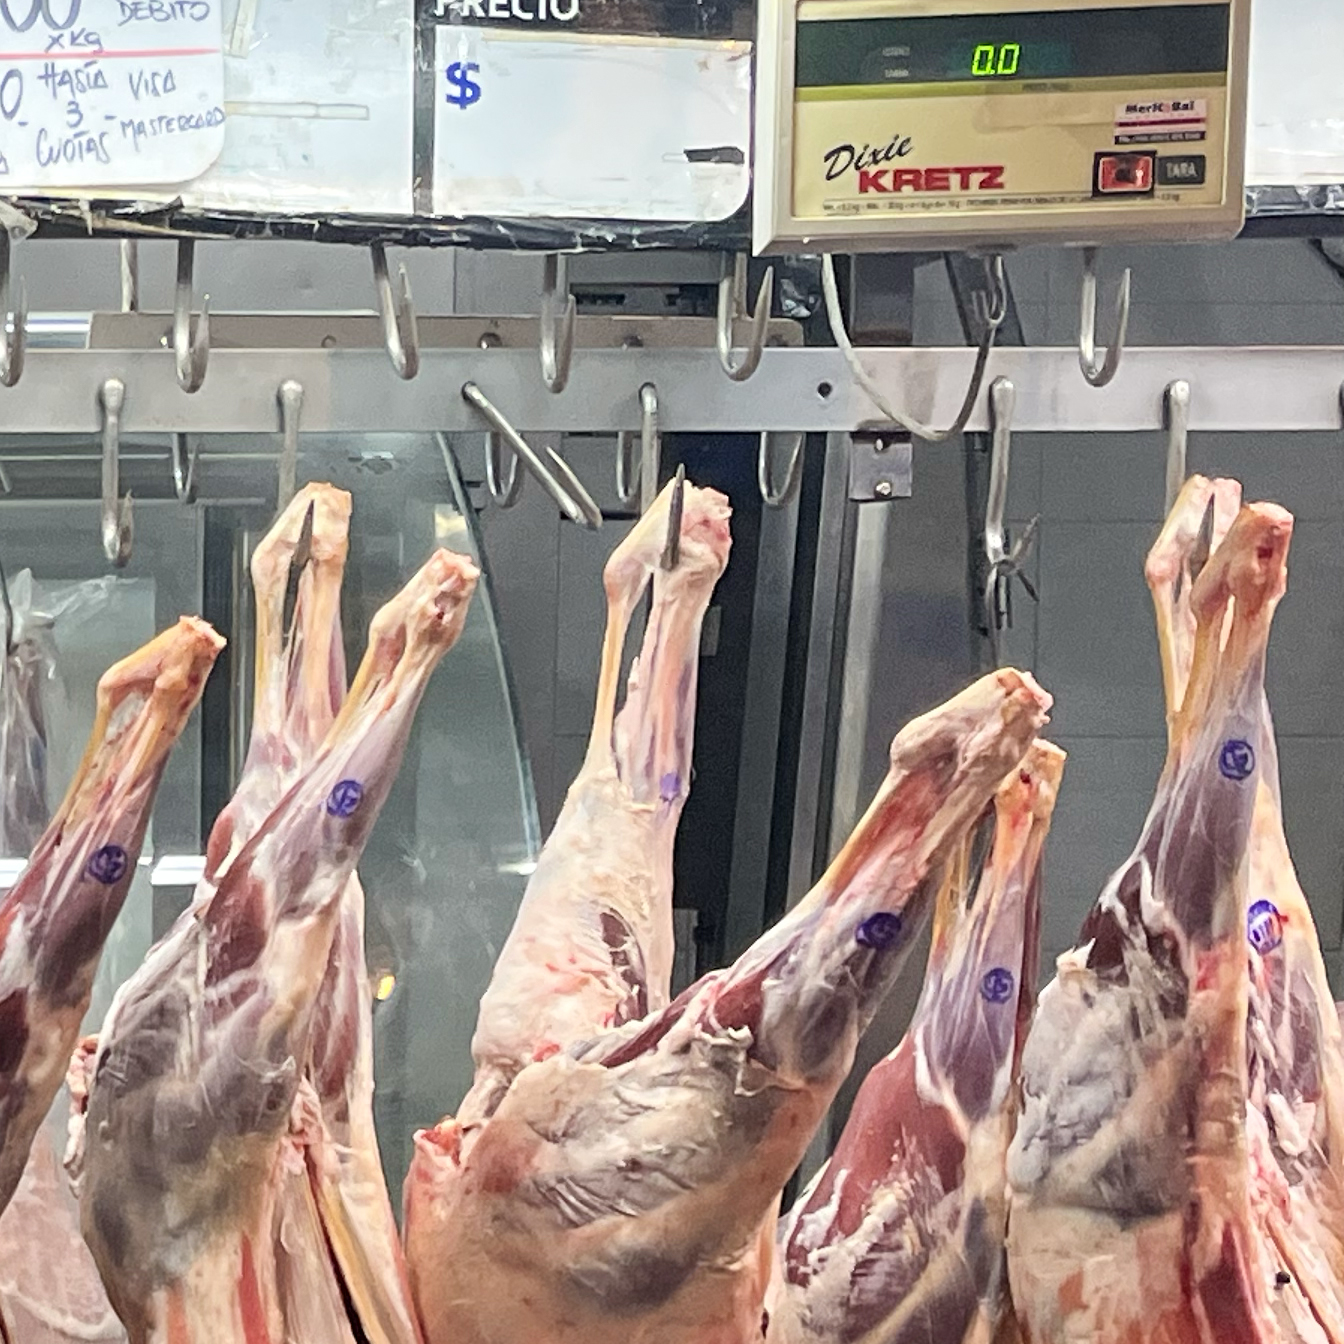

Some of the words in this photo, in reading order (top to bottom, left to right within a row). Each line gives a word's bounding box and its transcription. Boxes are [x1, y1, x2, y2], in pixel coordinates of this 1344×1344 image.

[117, 0, 211, 26] DEBITO
[971, 43, 1019, 76] 0.0
[445, 61, 482, 110] $
[65, 101, 85, 127] 3
[823, 134, 913, 181] Dixie
[858, 165, 1005, 194] KRETZ
